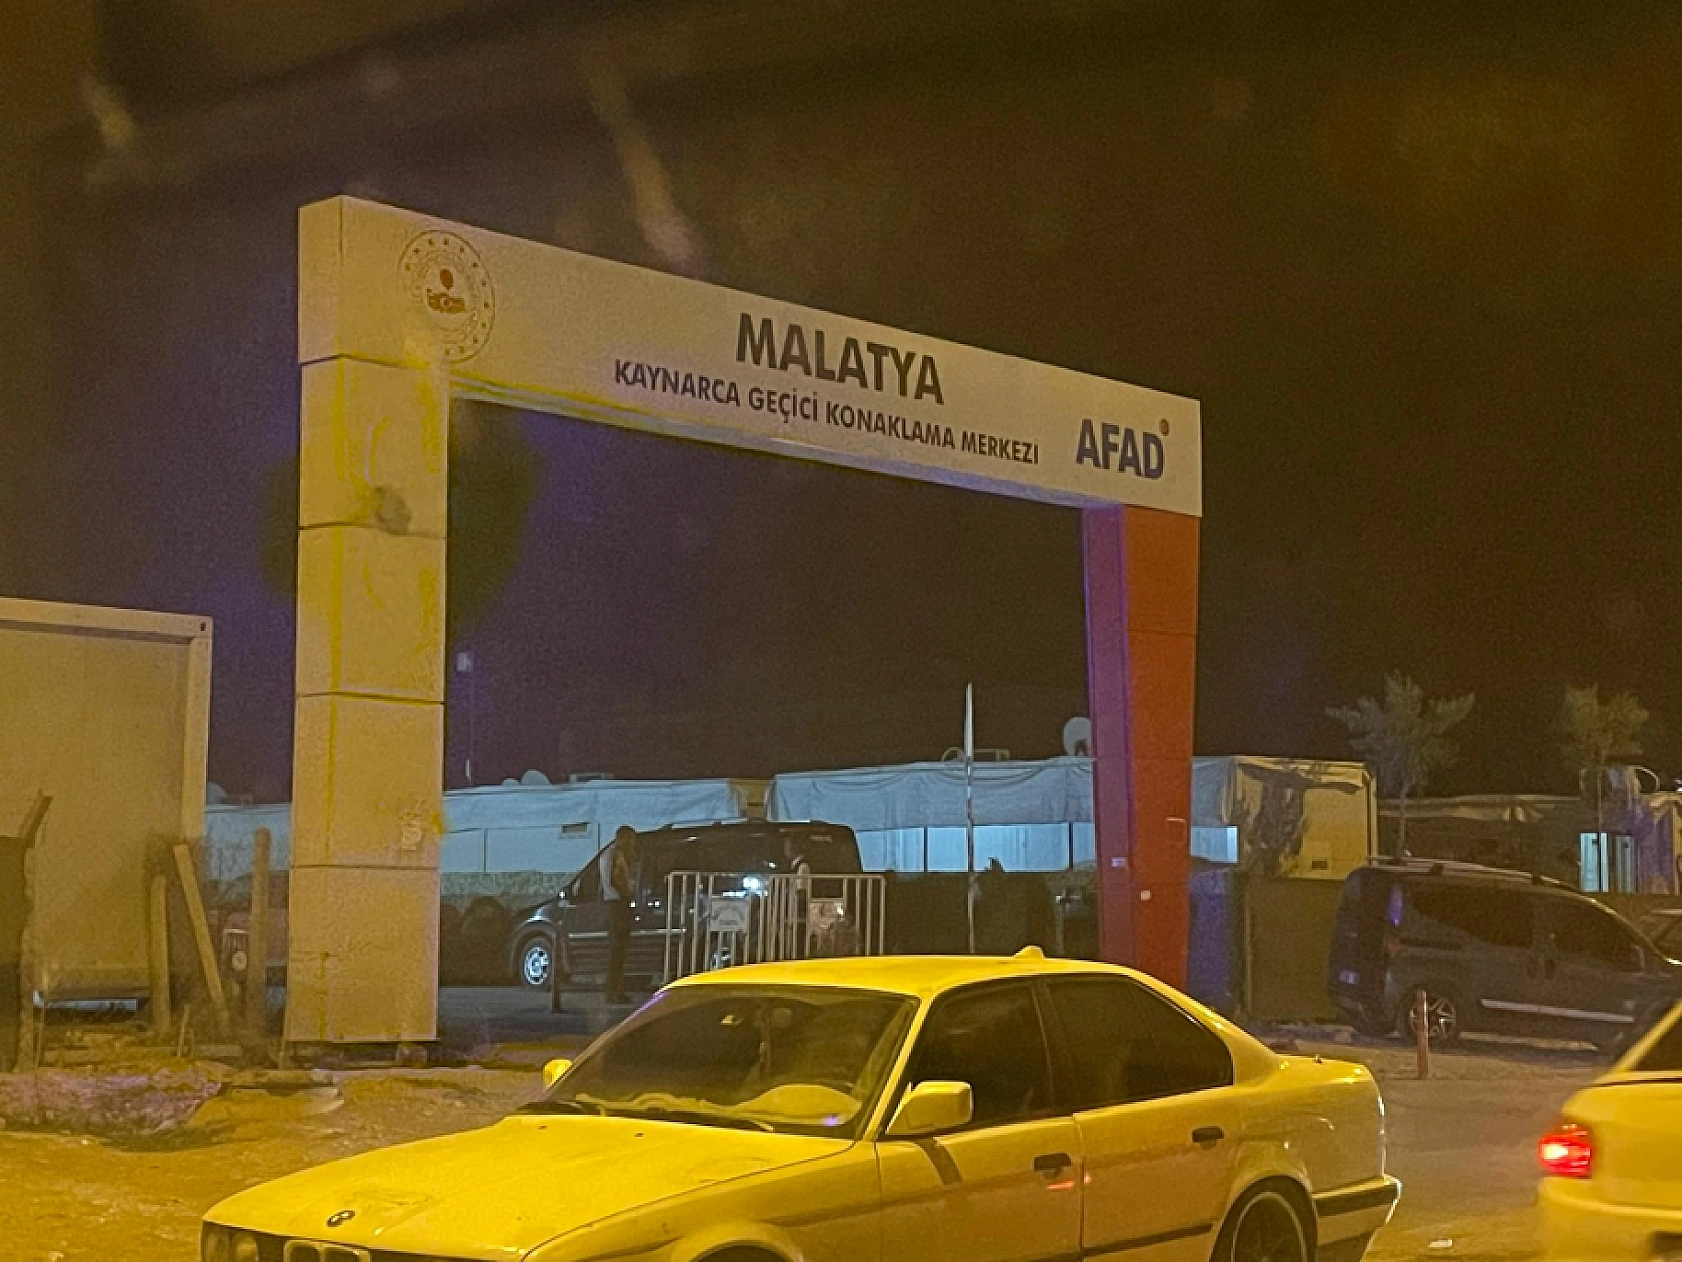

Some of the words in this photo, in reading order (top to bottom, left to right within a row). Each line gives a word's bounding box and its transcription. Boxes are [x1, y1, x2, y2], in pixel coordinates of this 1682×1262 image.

[736, 312, 944, 405] MALATYA
[615, 359, 740, 407] KAYNARCA
[749, 386, 818, 424] GEÇİCİ
[826, 400, 955, 450] KONAKLAMA
[1076, 418, 1164, 479] AFAD
